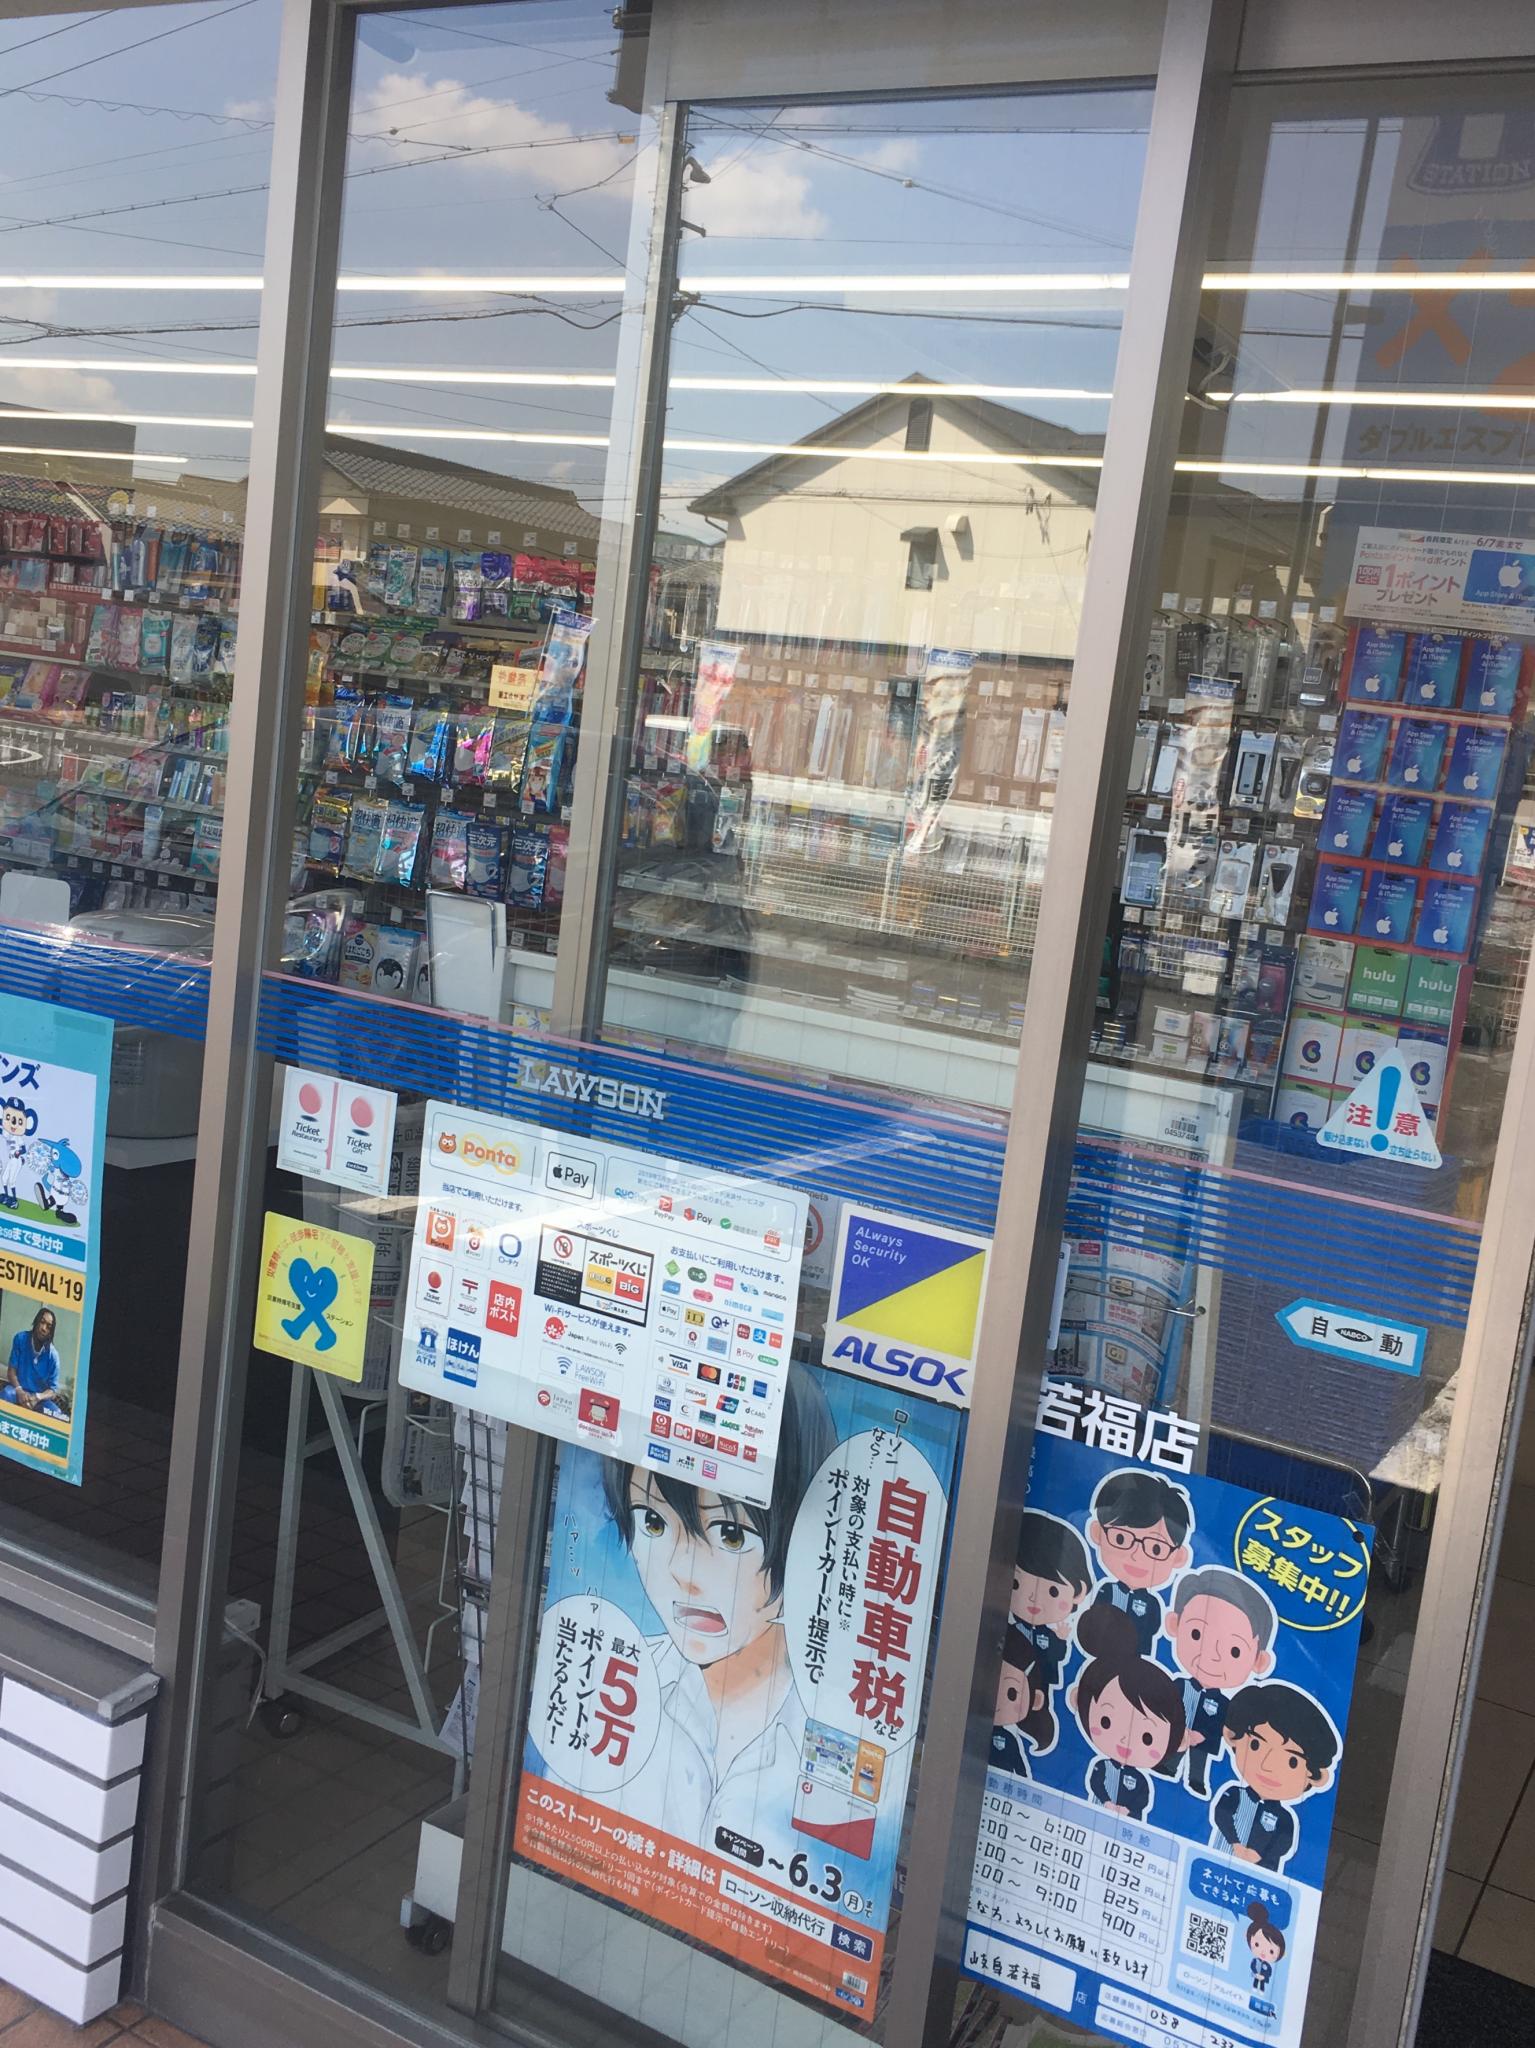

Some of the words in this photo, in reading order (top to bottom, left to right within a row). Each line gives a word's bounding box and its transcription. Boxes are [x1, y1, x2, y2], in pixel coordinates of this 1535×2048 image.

[1422, 159, 1532, 185] STATION
[1385, 563, 1461, 594] 1ポイント
[1376, 588, 1438, 606] プレゼント
[1363, 966, 1396, 984] hulu
[1418, 976, 1453, 993] hulu
[0, 1053, 41, 1091] ンズ
[518, 1055, 667, 1121] LAWSON
[296, 1121, 320, 1137] Ticket
[346, 1135, 373, 1151] Ticket
[463, 1141, 517, 1168] Ponta
[564, 1165, 589, 1187] Pay
[442, 1182, 524, 1213] 当店でご利用いただけます。
[577, 1222, 620, 1239] スポーツくじ
[696, 1212, 713, 1225] Pay
[855, 1226, 903, 1247] ALways
[588, 1250, 648, 1278] スポーツくじ
[670, 1245, 785, 1285] お支払いにご利用いただけます。
[851, 1254, 871, 1268] OK
[853, 1240, 907, 1264] Security
[489, 1306, 517, 1323] ポスト
[494, 1293, 516, 1310] 店内
[447, 1336, 479, 1359] ほけん
[1340, 1328, 1368, 1341] NABCO
[415, 1355, 436, 1368] ATM
[671, 1359, 688, 1371] VISA
[832, 1335, 968, 1396] ALSOK
[885, 1408, 910, 1465] ローソン
[1254, 1507, 1364, 1580] スタッフ
[804, 1467, 850, 1685] ポイントカード提示で
[1242, 1537, 1351, 1620] 募集中!!
[848, 1477, 928, 1730] 自動車税
[611, 1636, 641, 1663] 最大
[568, 1626, 605, 1750] ポイントが
[590, 1656, 639, 1767] 5万
[873, 1719, 900, 1742] など
[527, 1787, 717, 1887] このストーリーの続き・詳細は
[721, 1829, 760, 1853] キャンペーン
[1103, 1840, 1145, 1869] 1032
[1100, 1864, 1141, 1893] 1032
[1202, 1867, 1280, 1906] ネットで応募も
[1103, 1889, 1139, 1916] 825
[1199, 1882, 1246, 1908] できるよ!
[725, 1878, 826, 1938] ローソン収納代行
[836, 1930, 867, 1956] 検索
[1101, 1911, 1136, 1938] 900
[1150, 2008, 1180, 2030] 058
